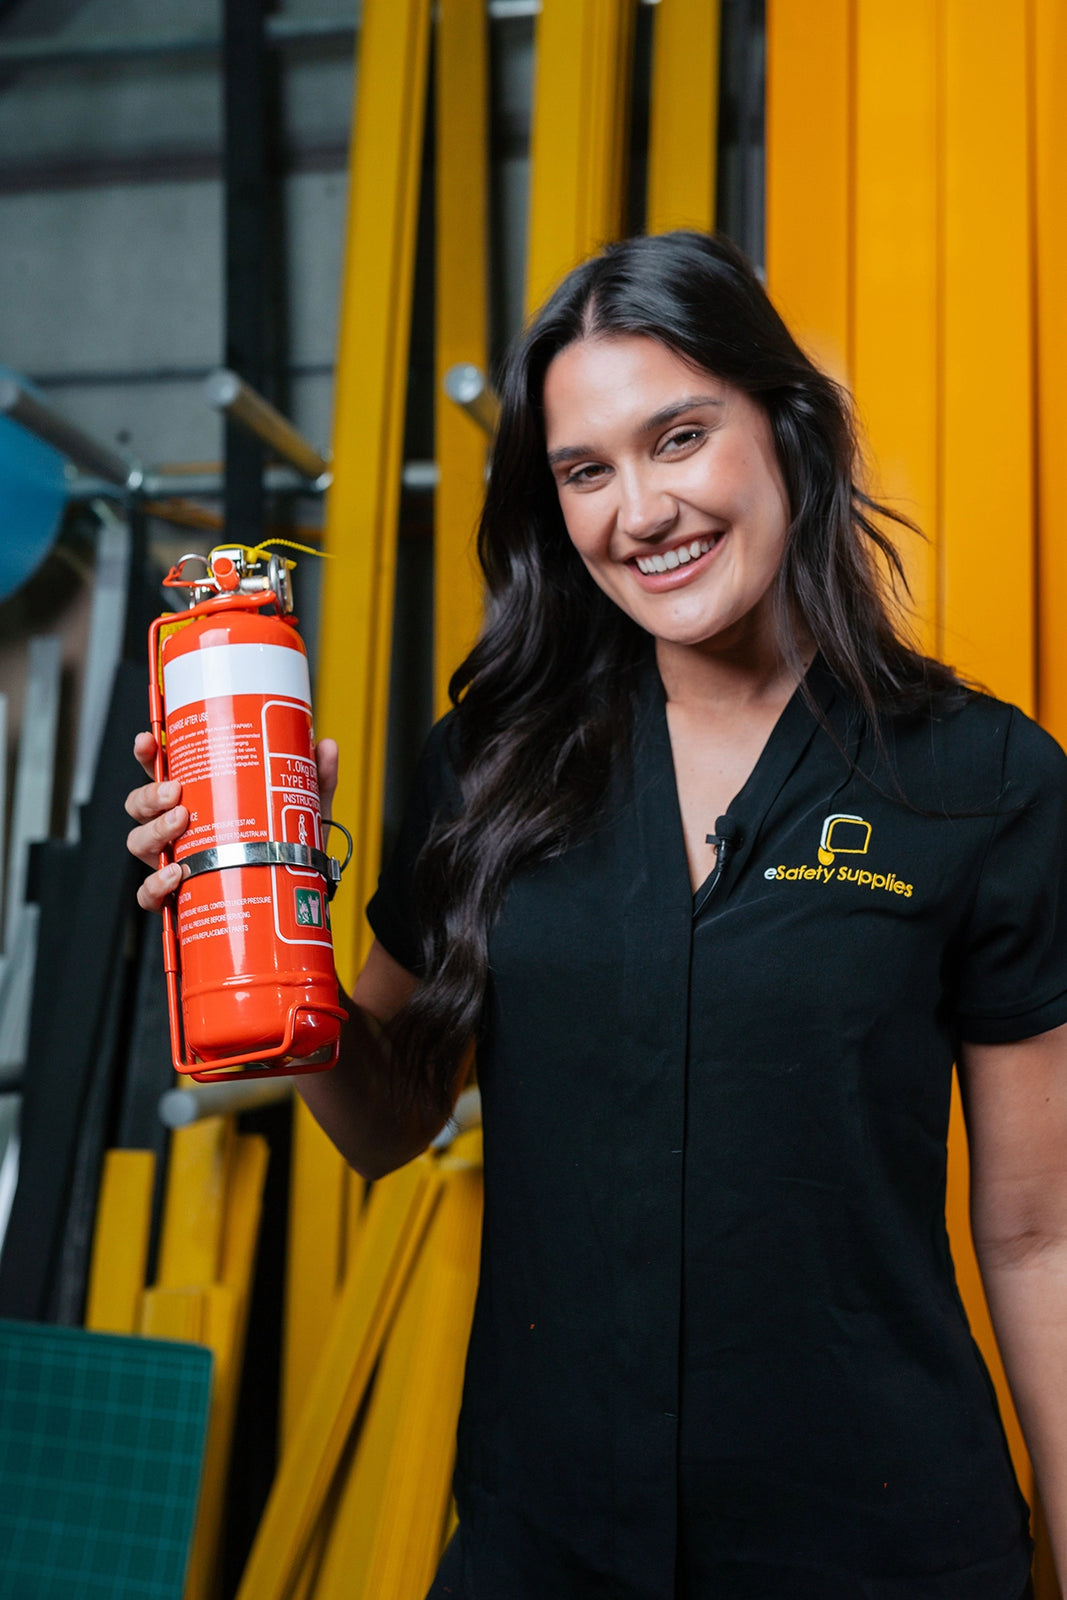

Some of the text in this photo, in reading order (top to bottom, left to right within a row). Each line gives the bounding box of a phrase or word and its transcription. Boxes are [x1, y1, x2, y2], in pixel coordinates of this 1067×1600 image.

[286, 759, 310, 778] 1.0kg
[280, 773, 303, 789] TYPE
[246, 818, 256, 826] AND
[764, 864, 914, 898] eSafety Supplies
[247, 896, 271, 905] PRESSURE
